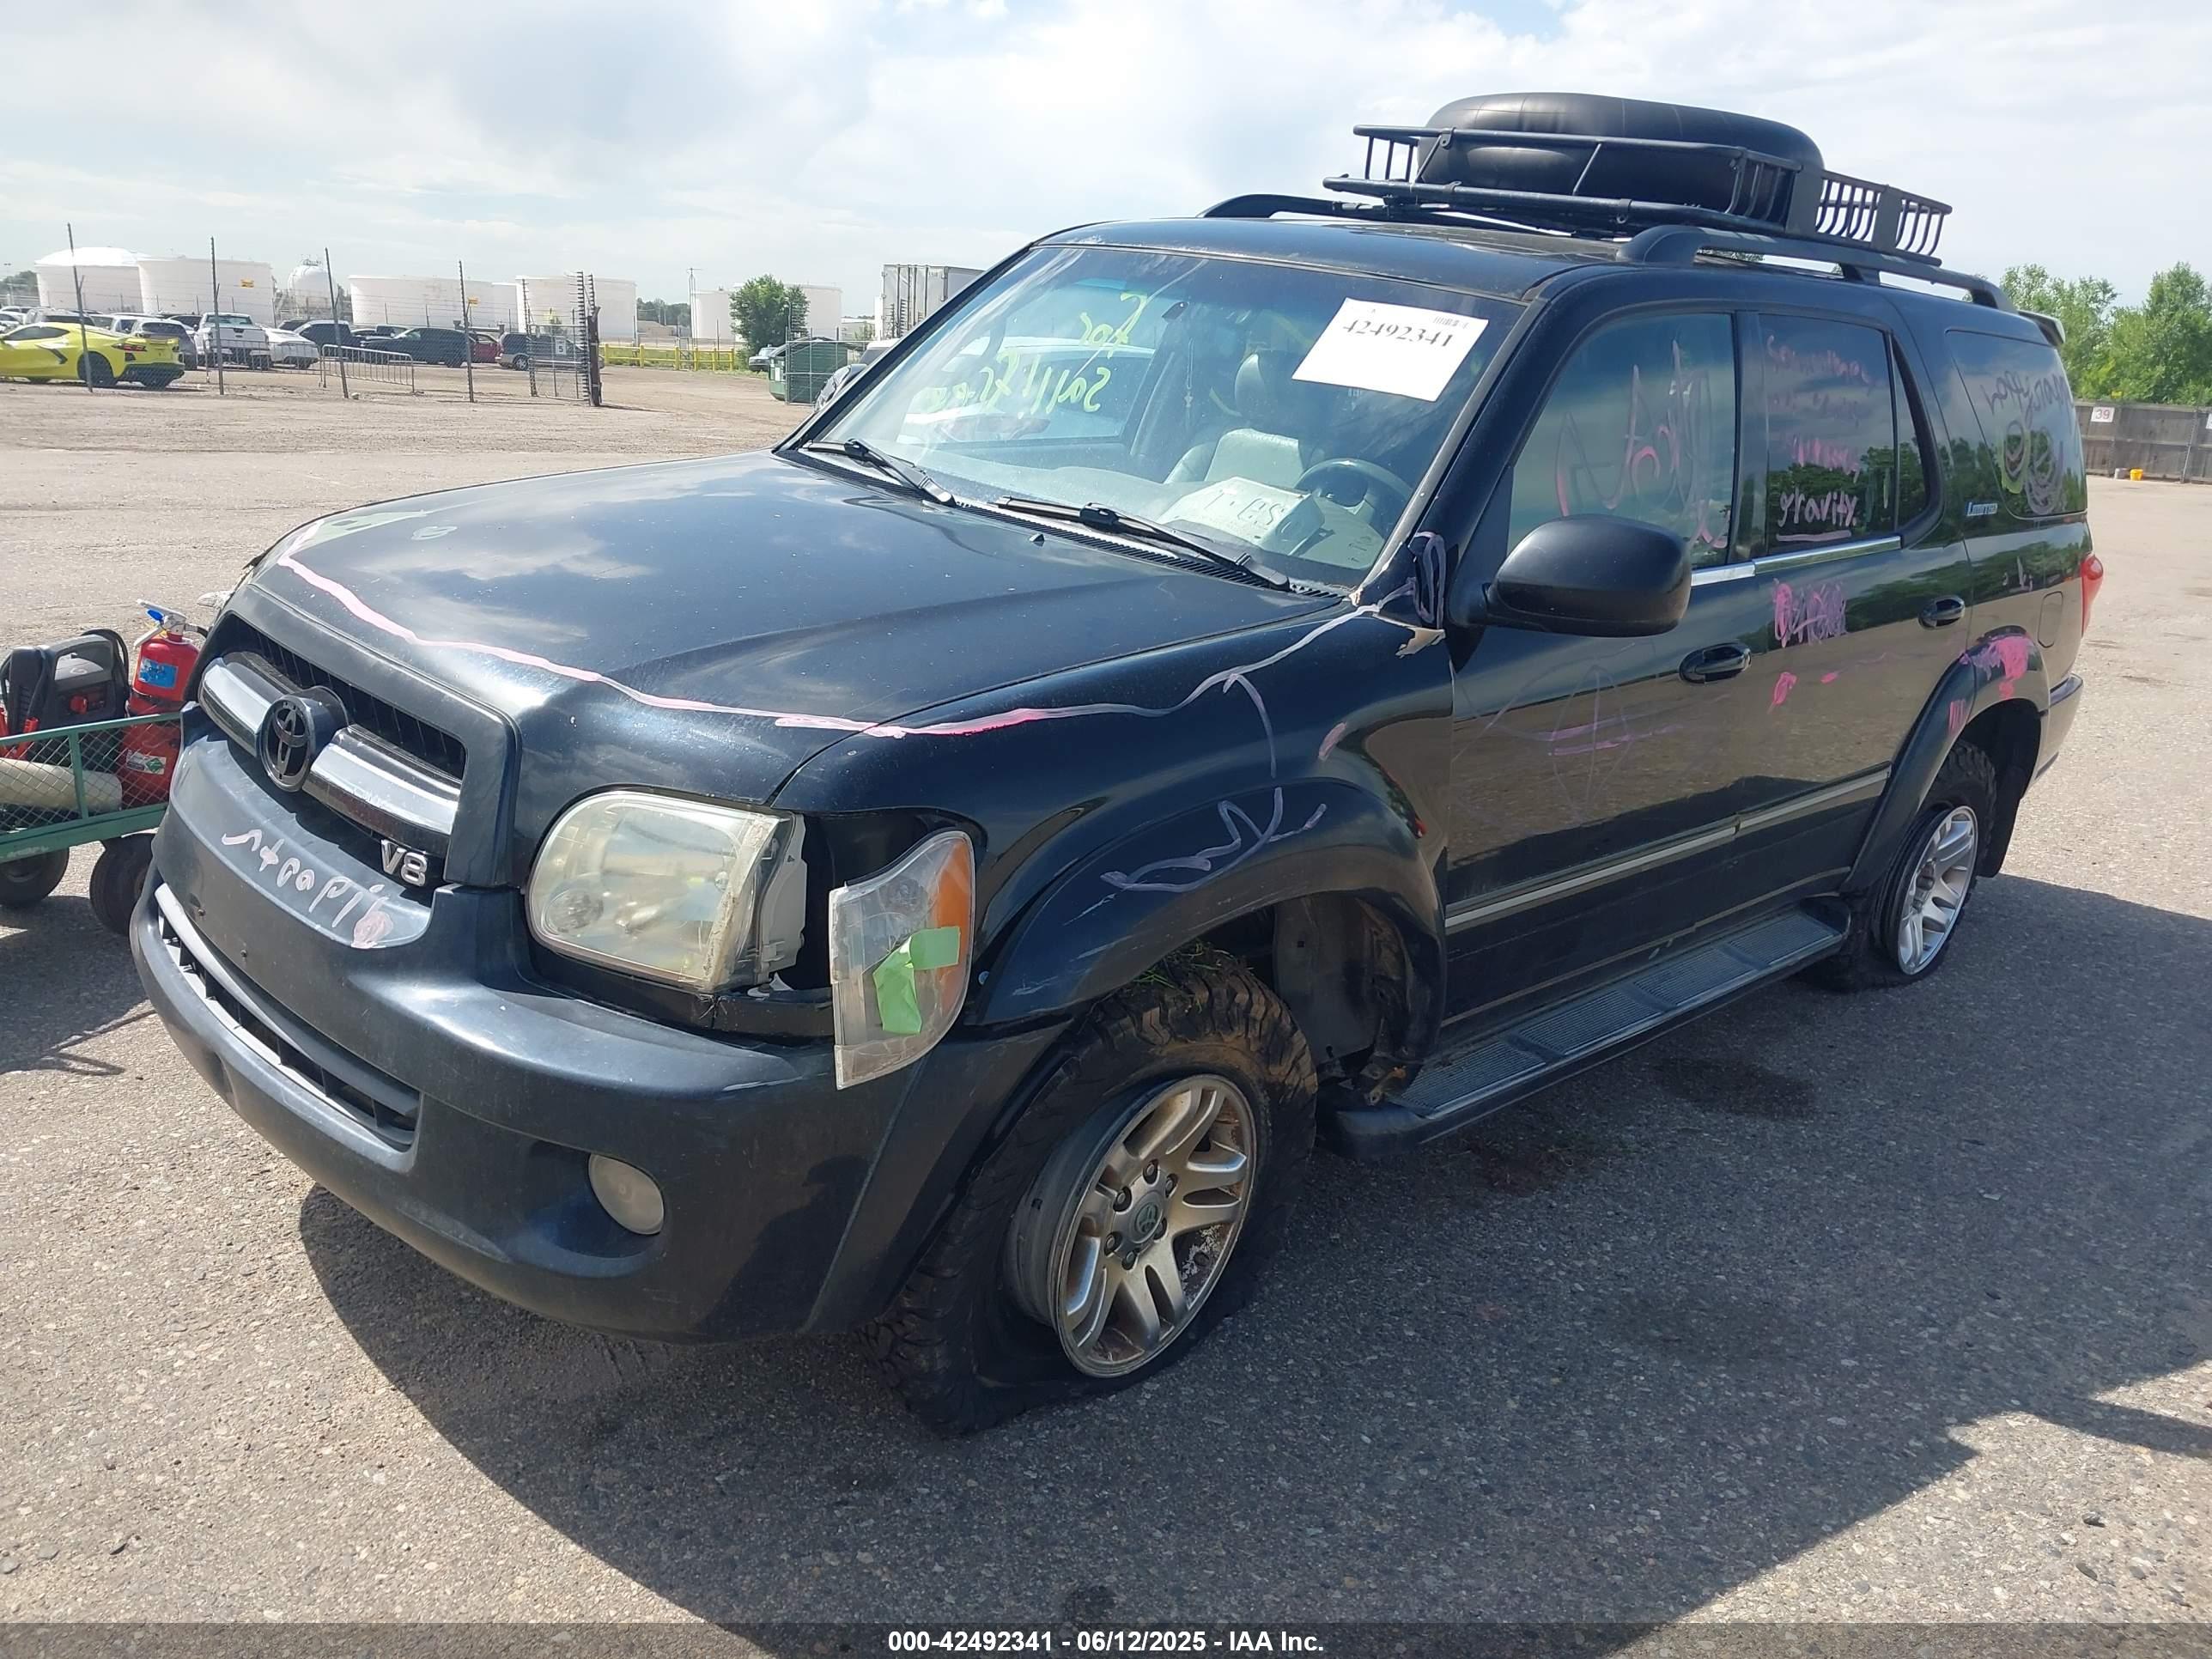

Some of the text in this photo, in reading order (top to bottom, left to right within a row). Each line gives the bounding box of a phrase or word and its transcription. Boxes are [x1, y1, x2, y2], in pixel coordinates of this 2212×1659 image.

[1342, 319, 1454, 347] 42492341
[2095, 409, 2111, 420] 39
[380, 838, 428, 887] V8
